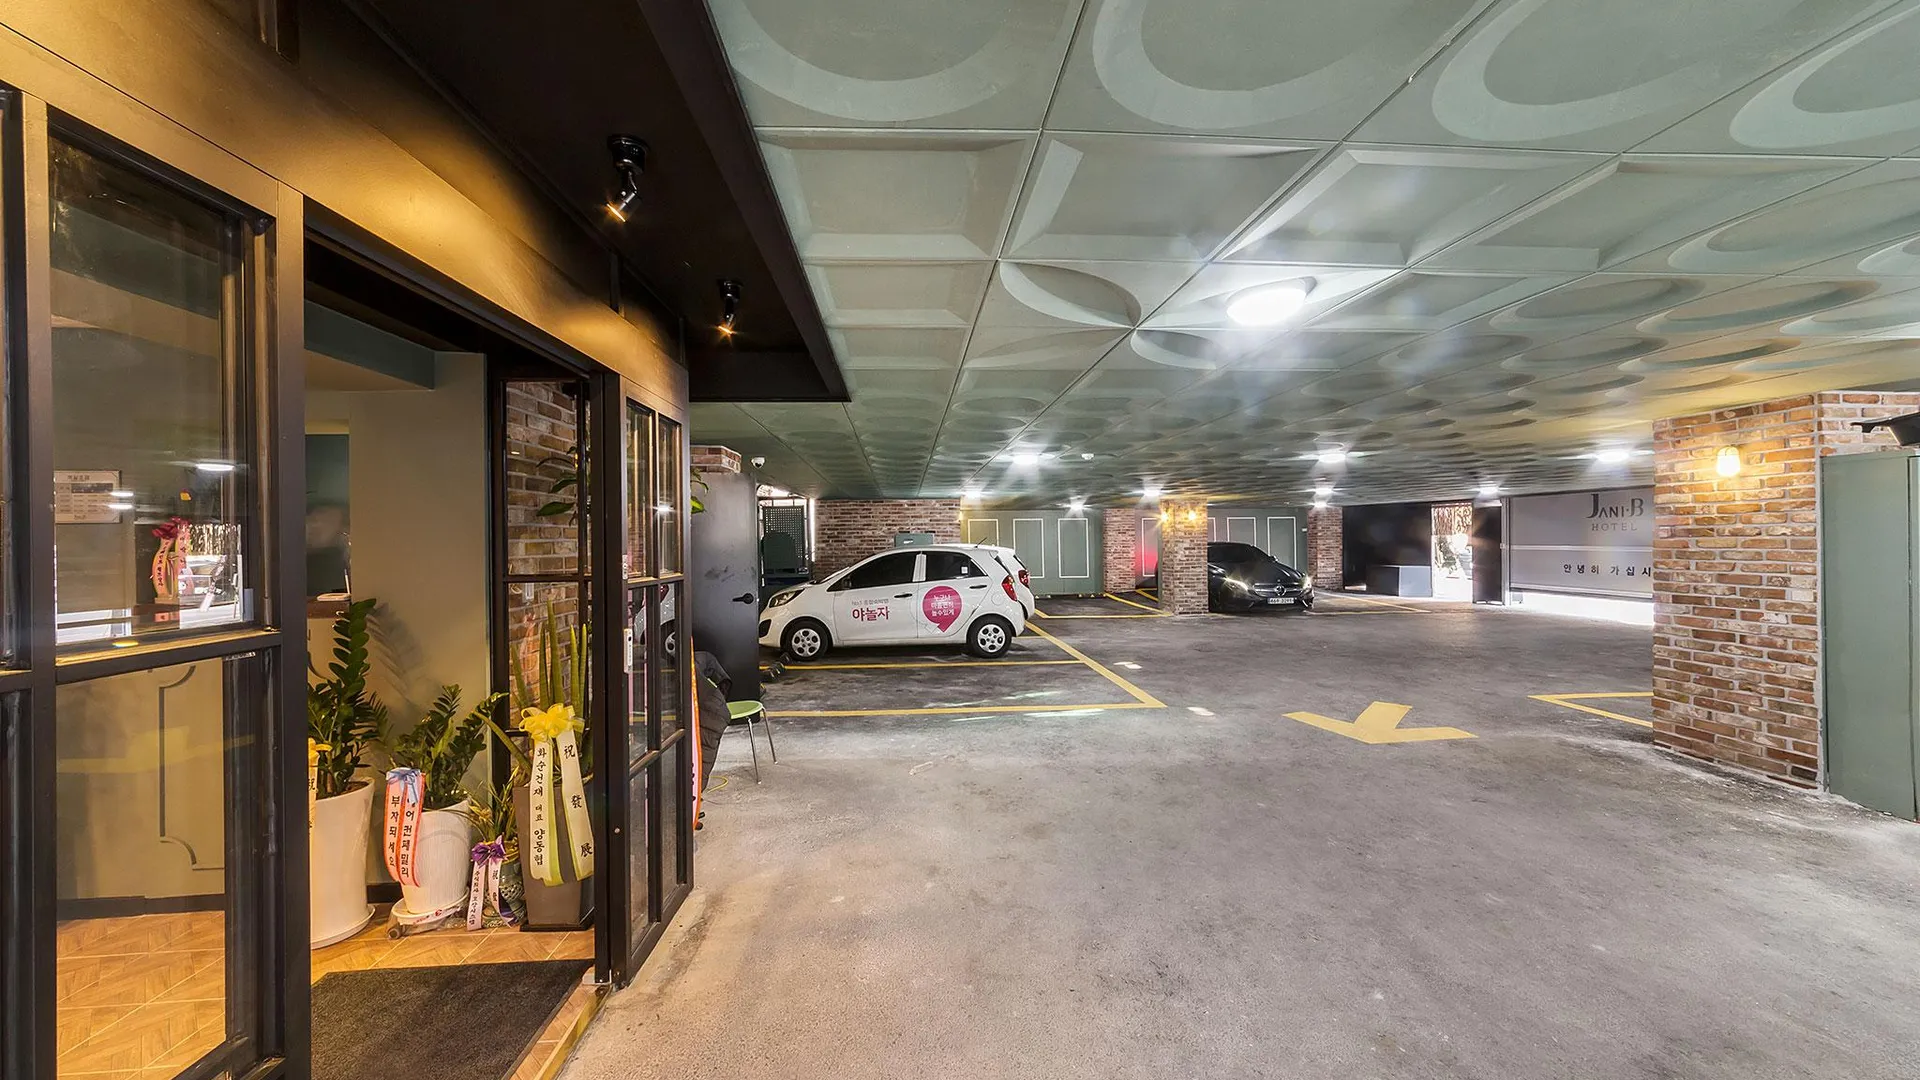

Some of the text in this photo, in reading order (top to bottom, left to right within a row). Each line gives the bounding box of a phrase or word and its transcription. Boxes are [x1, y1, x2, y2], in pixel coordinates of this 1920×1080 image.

[1591, 523, 1637, 532] HOTEL
[1563, 564, 1600, 575] 안녕히
[852, 606, 890, 621] 야놀자
[401, 798, 416, 878] 어컨패밀리
